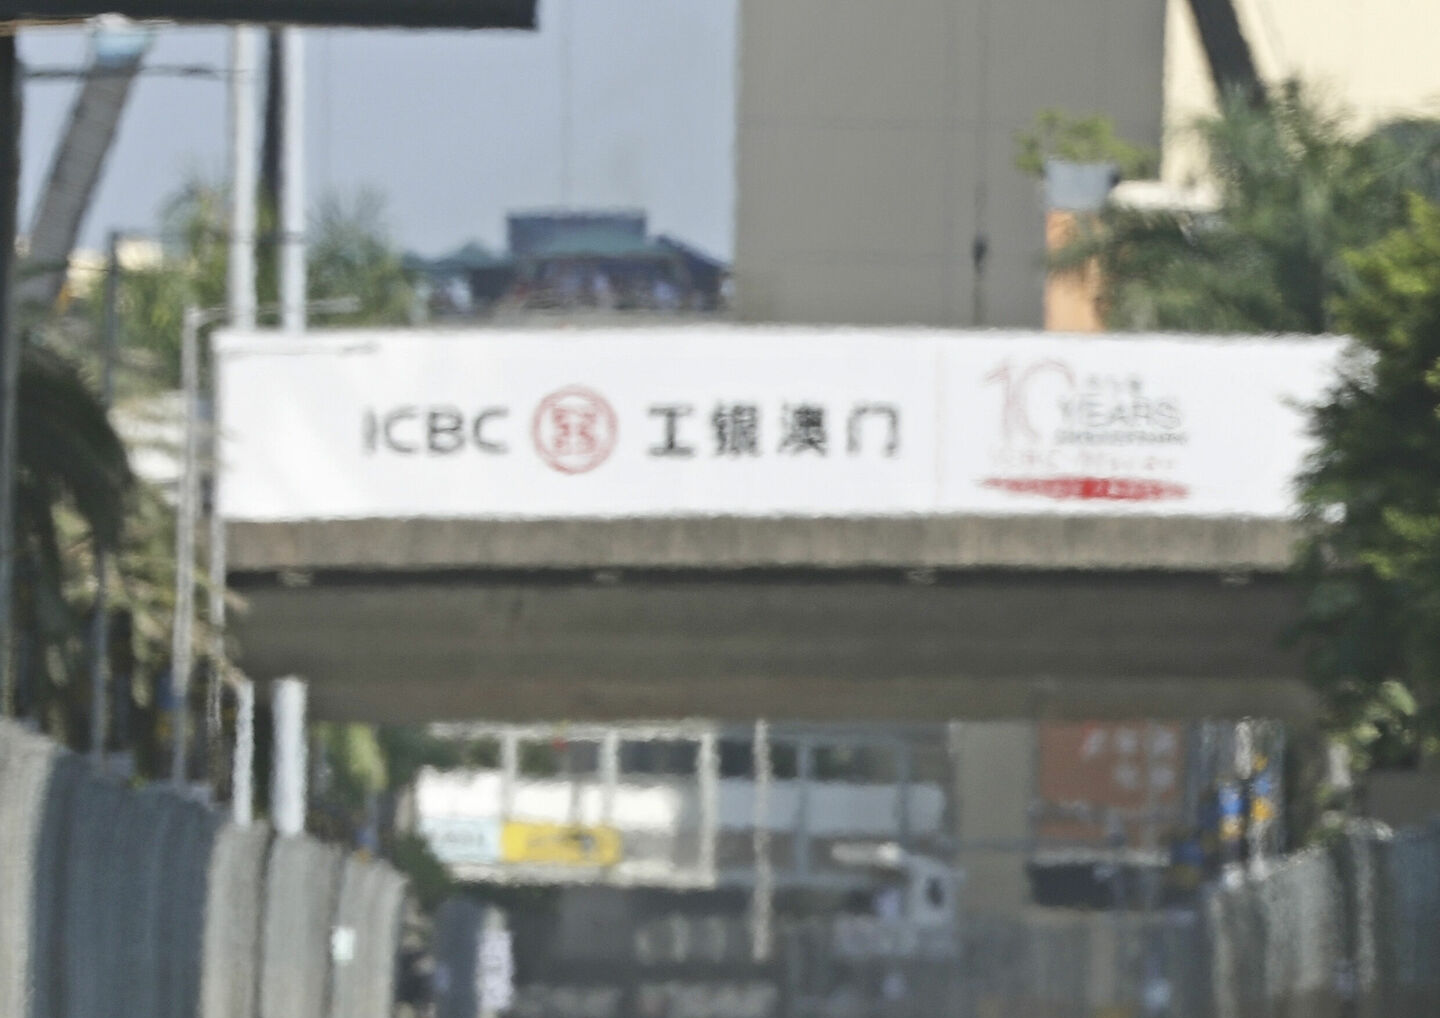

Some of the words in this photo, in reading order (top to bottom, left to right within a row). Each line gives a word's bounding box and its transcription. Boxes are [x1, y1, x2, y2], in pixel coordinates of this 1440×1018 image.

[362, 405, 509, 454] ICBC
[646, 402, 899, 457] 工银澳门
